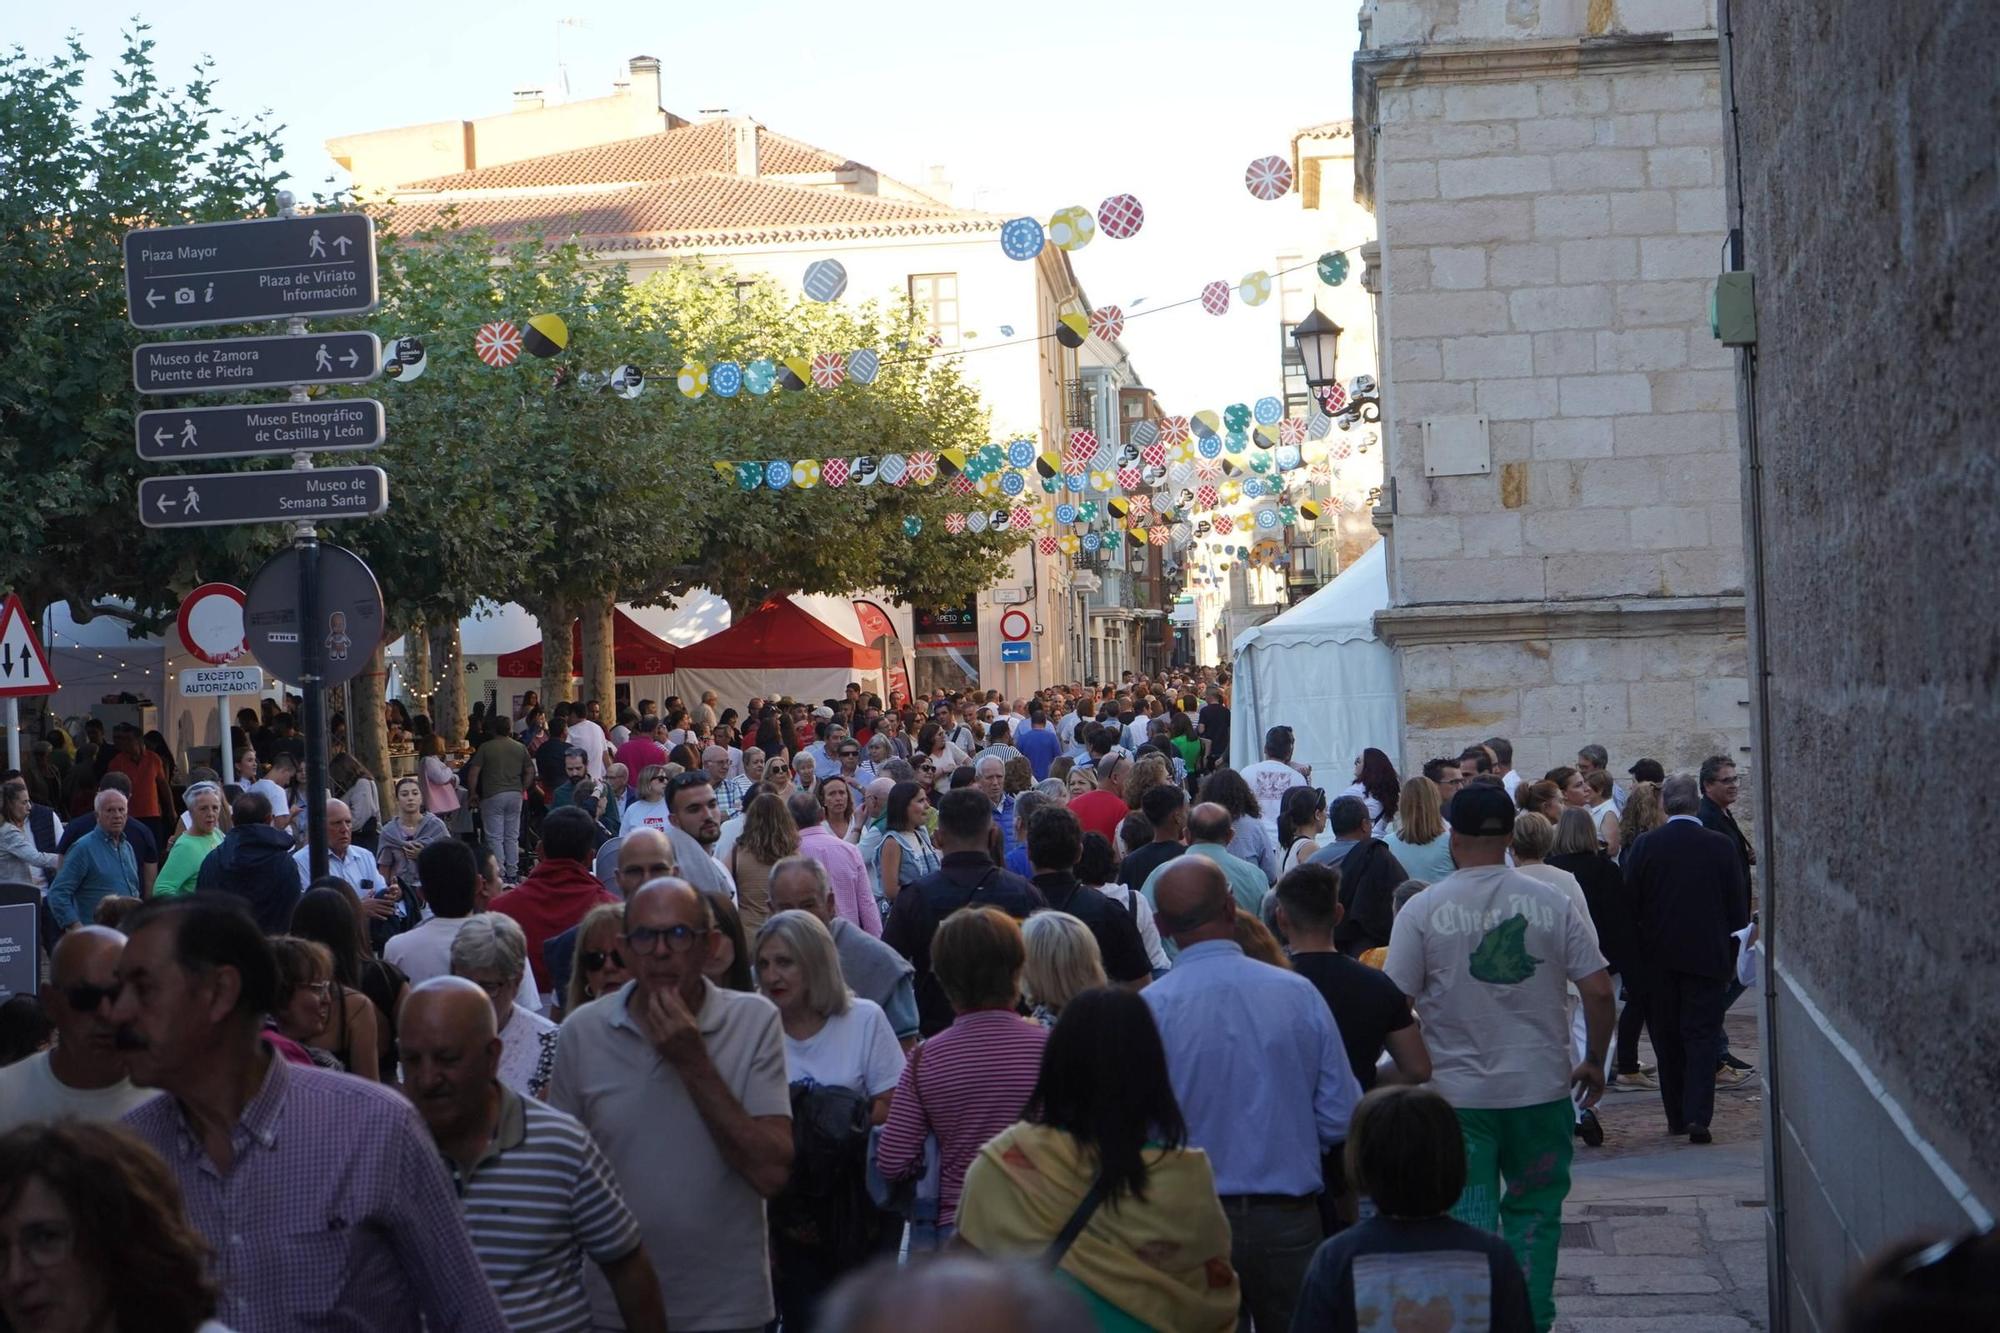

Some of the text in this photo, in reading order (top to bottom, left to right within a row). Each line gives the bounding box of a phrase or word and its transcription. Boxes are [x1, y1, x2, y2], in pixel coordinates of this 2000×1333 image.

[142, 246, 218, 262] Plaza Mayor
[259, 269, 356, 287] Plaza de Viriato
[283, 283, 357, 301] Información
[150, 350, 259, 366] Museo de Zamora
[150, 364, 254, 381] Puente de Piedra
[247, 408, 363, 426] Museo Etnográfico
[255, 424, 364, 442] de Castilla y León
[306, 477, 366, 492] Museo de
[279, 494, 367, 510] Semana Santa
[196, 670, 245, 681] EXCEPTO
[185, 681, 258, 693] AUTORIZADOS
